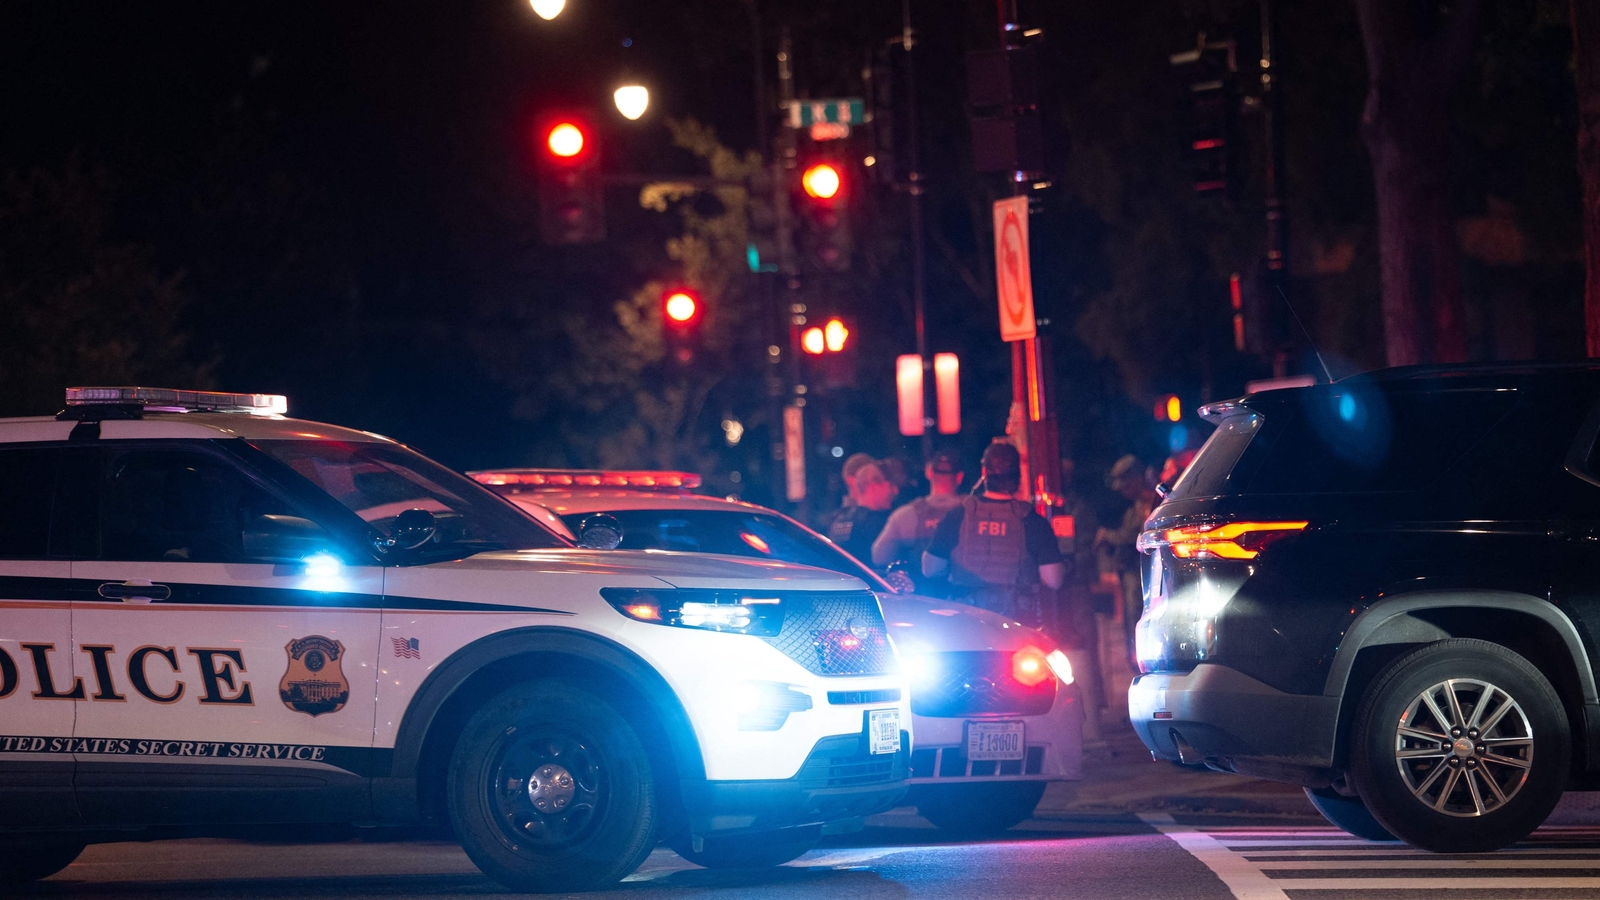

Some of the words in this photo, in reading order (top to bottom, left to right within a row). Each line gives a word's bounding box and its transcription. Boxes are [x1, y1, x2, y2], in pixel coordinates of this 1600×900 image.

[978, 521, 1007, 536] FBI
[0, 736, 46, 751] TED
[50, 738, 130, 754] STATES
[135, 740, 225, 757] SECRET
[228, 743, 325, 761] SERVICE
